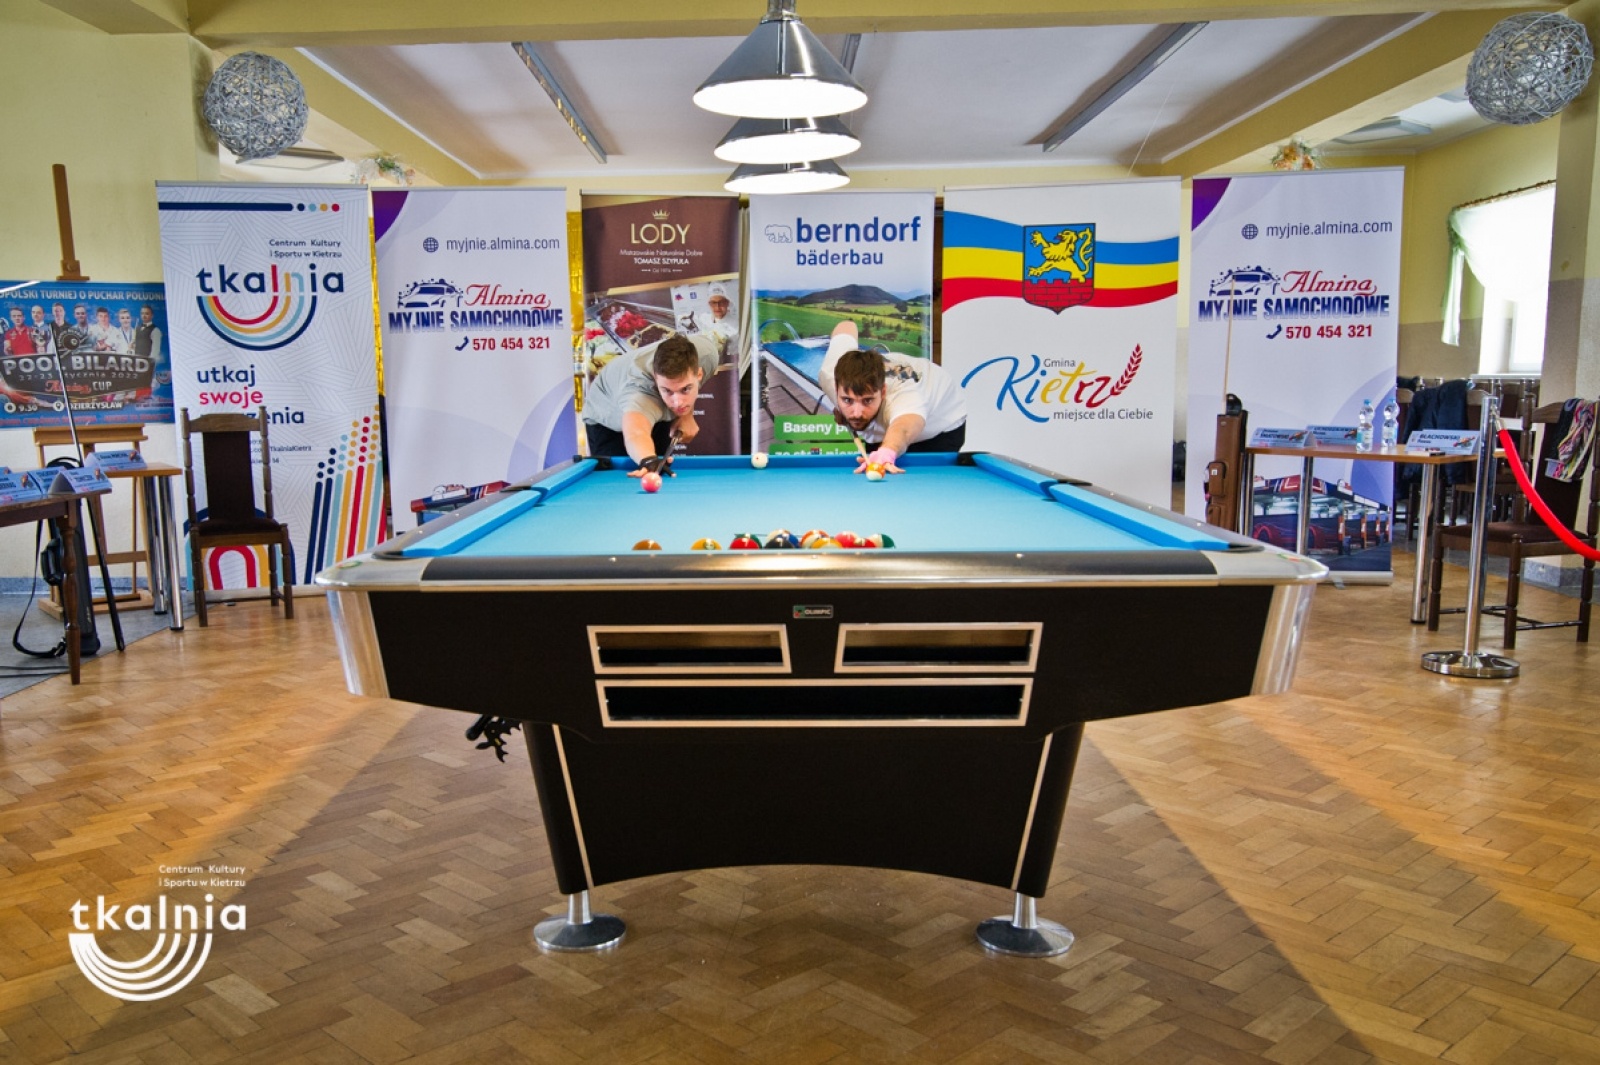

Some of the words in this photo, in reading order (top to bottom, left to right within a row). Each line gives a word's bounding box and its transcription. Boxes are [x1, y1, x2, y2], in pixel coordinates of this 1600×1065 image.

[630, 223, 691, 245] LODY
[796, 215, 922, 244] berndorf
[1266, 220, 1393, 240] myjnie.almina.com
[269, 239, 306, 247] Centrum
[310, 239, 341, 249] Kultury
[446, 237, 560, 253] myjnie.almina.com
[274, 250, 302, 259] Sportu
[313, 250, 342, 258] Kietrzu
[796, 249, 883, 266] bäderbau
[196, 263, 344, 294] tkalnia
[1281, 270, 1378, 297] Almina
[40, 289, 77, 299] TURNIEJ
[79, 290, 86, 299] O
[88, 290, 124, 300] PUCHAR
[464, 284, 552, 311] Almina
[1198, 298, 1257, 322] MYJNIE
[1263, 295, 1390, 320] SAMOCHODOWE
[388, 310, 446, 334] MYJNIE
[450, 308, 563, 332] SAMOCHODOWE
[1286, 326, 1311, 339] 570
[1317, 325, 1342, 338] 454
[1347, 325, 1373, 338] 321
[473, 338, 496, 351] 570
[501, 337, 523, 350] 454
[528, 336, 550, 349] 321
[72, 355, 149, 373] BILARD
[1043, 358, 1076, 368] Gmina
[64, 371, 106, 380] tycznia
[196, 364, 256, 387] utkaj
[92, 381, 113, 392] CUP
[961, 354, 1112, 423] Kietrz
[199, 386, 264, 409] swoje
[1053, 408, 1096, 422] miejsce
[1097, 408, 1115, 420] dla
[1117, 408, 1154, 420] Ciebie
[783, 422, 833, 436] Baseny
